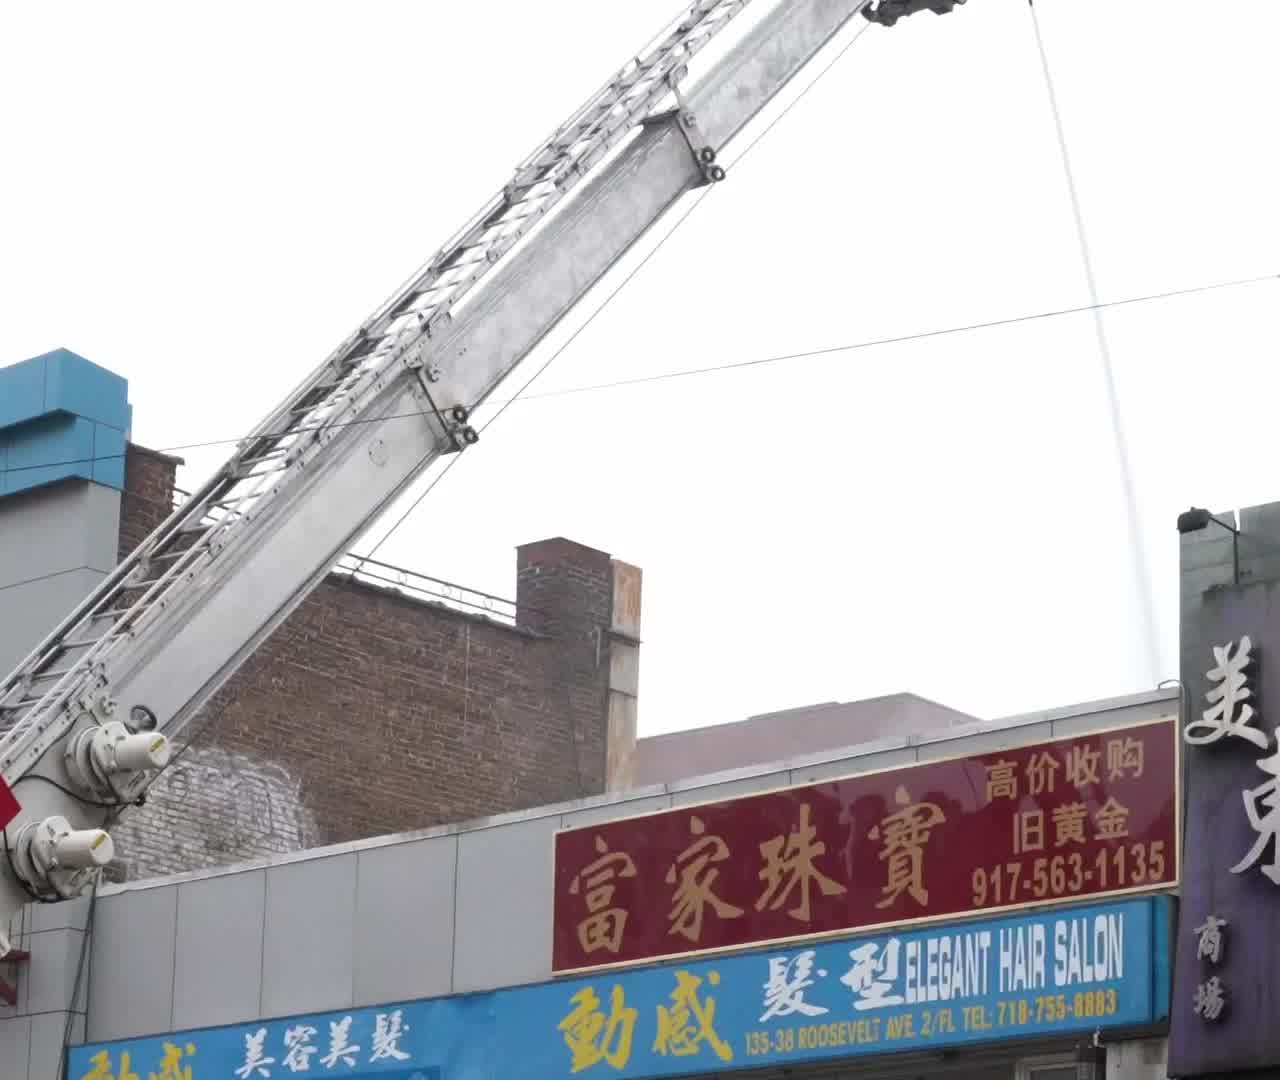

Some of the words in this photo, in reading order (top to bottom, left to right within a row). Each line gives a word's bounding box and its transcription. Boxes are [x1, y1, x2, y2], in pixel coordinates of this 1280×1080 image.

[985, 736, 1144, 801] 高价收购
[1013, 797, 1130, 853] 旧黄金
[569, 783, 946, 955] 富家珠寶
[971, 841, 1166, 907] 917-563-1135
[759, 935, 906, 1023] 髮型
[905, 930, 992, 1004] ELEGANT
[999, 922, 1047, 993] HAIR
[1054, 914, 1125, 982] SALON
[1193, 914, 1227, 1021] 商場
[234, 1009, 412, 1080] 美容美髮
[558, 970, 733, 1075] 動感
[744, 1030, 795, 1057] 135-38
[797, 1018, 881, 1050] ROOSEVELT
[962, 1005, 993, 1031] TEL:
